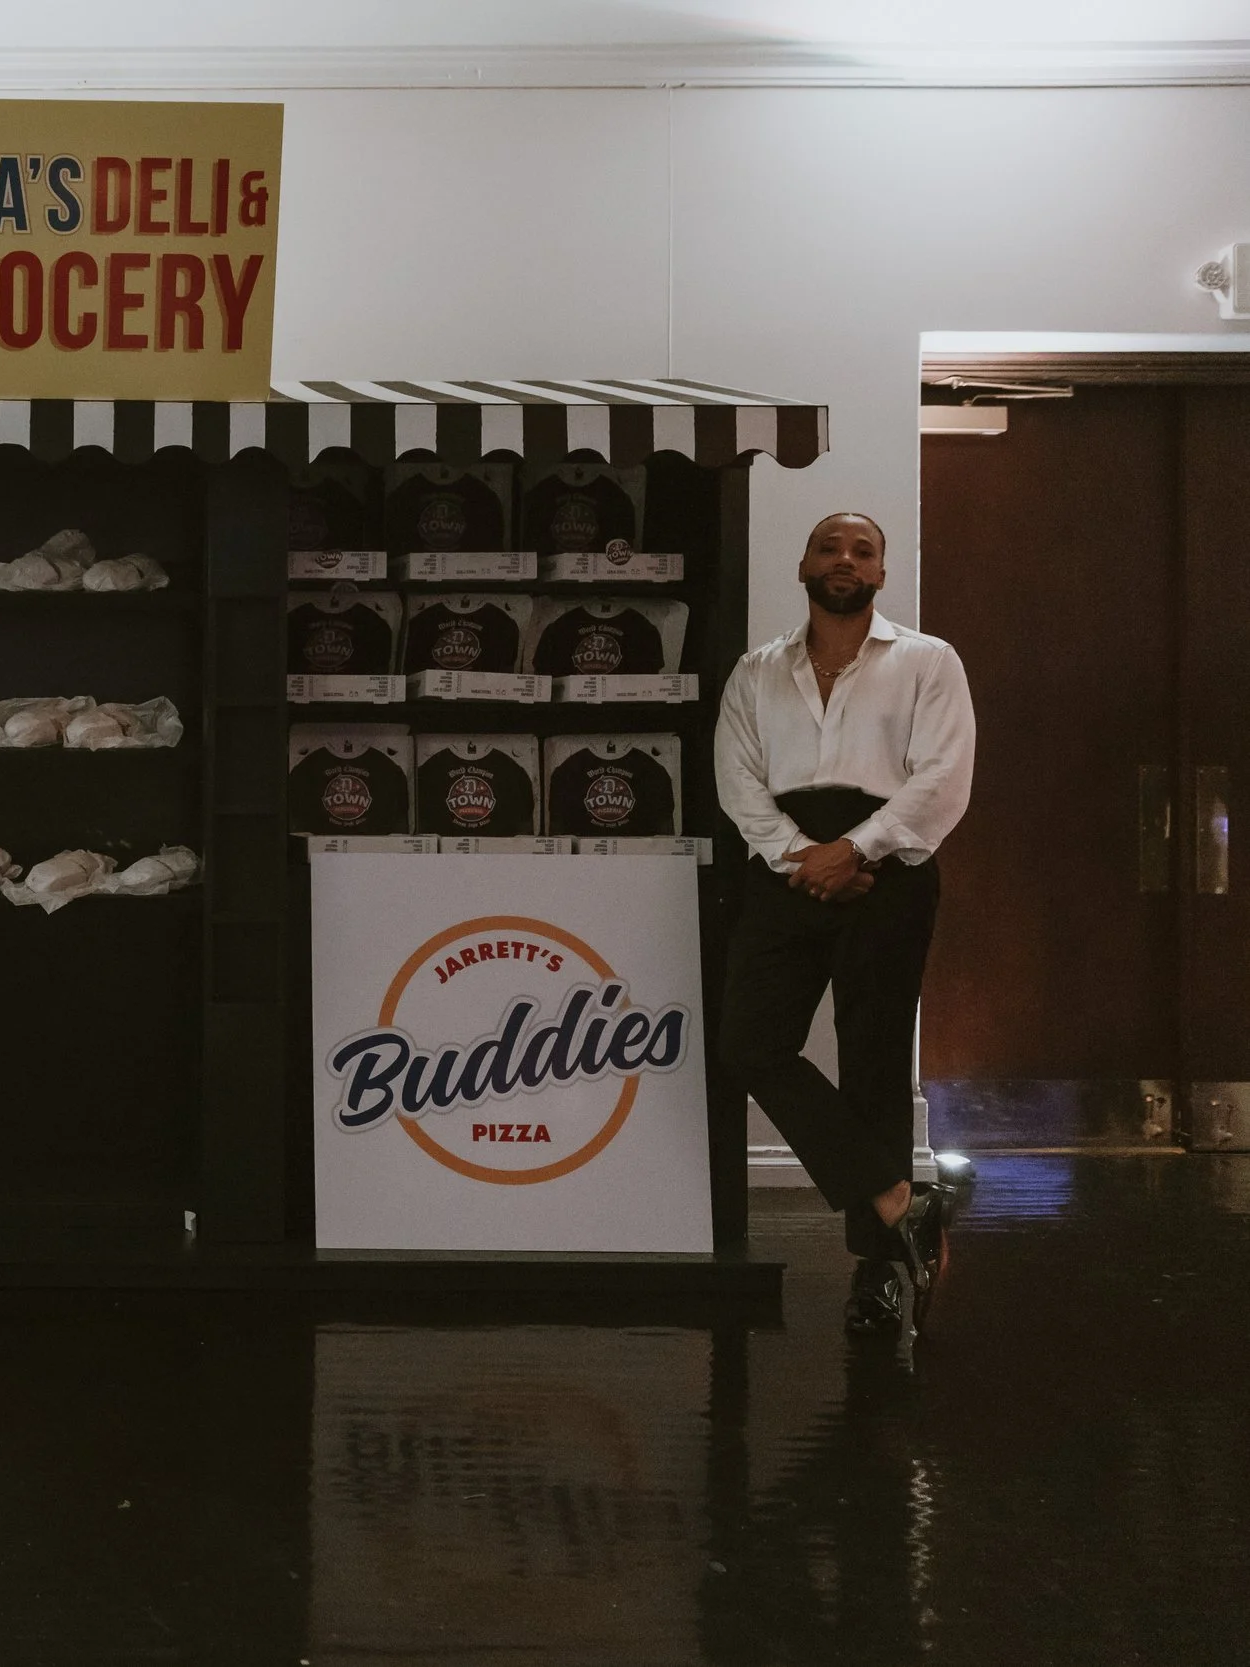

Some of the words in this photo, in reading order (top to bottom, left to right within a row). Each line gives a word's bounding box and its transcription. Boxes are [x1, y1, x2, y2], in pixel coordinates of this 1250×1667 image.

[91, 156, 230, 237] DELI
[238, 170, 269, 228] &
[306, 643, 351, 657] TOWN
[434, 645, 479, 657] TOWN
[575, 651, 620, 664] TOWN
[602, 778, 616, 794] D
[324, 793, 370, 807] TOWN
[448, 795, 494, 809] TOWN
[586, 795, 633, 809] TOWN
[433, 940, 565, 984] JARRETT'S
[330, 982, 686, 1128] Buddies
[471, 1123, 552, 1143] PIZZA
